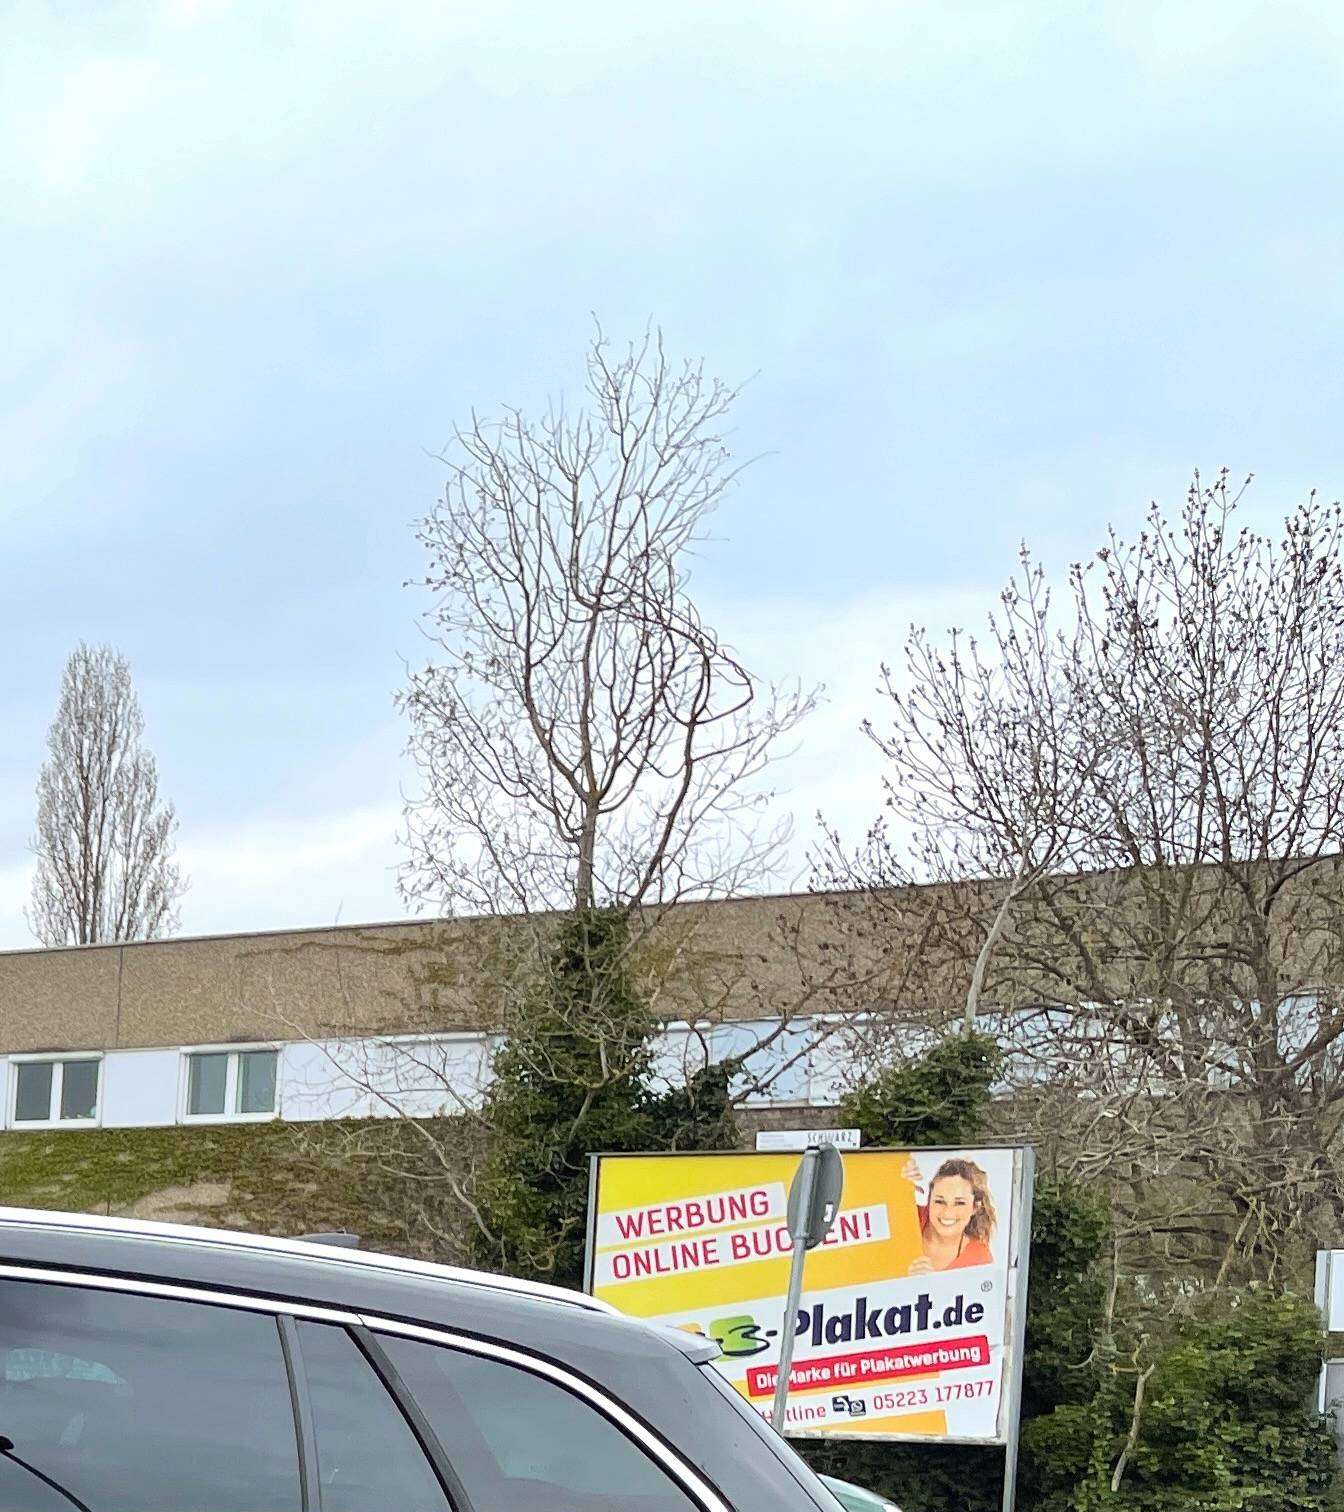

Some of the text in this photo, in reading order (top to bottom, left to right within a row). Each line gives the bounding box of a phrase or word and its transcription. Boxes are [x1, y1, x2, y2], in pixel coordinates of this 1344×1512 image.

[615, 1191, 769, 1240] WERBUNG
[612, 1211, 872, 1279] ONLINE BUCEN!
[833, 1361, 858, 1379] für
[860, 1345, 981, 1374] Plakatwerbung
[762, 1379, 994, 1425] Htline 05223 177877
